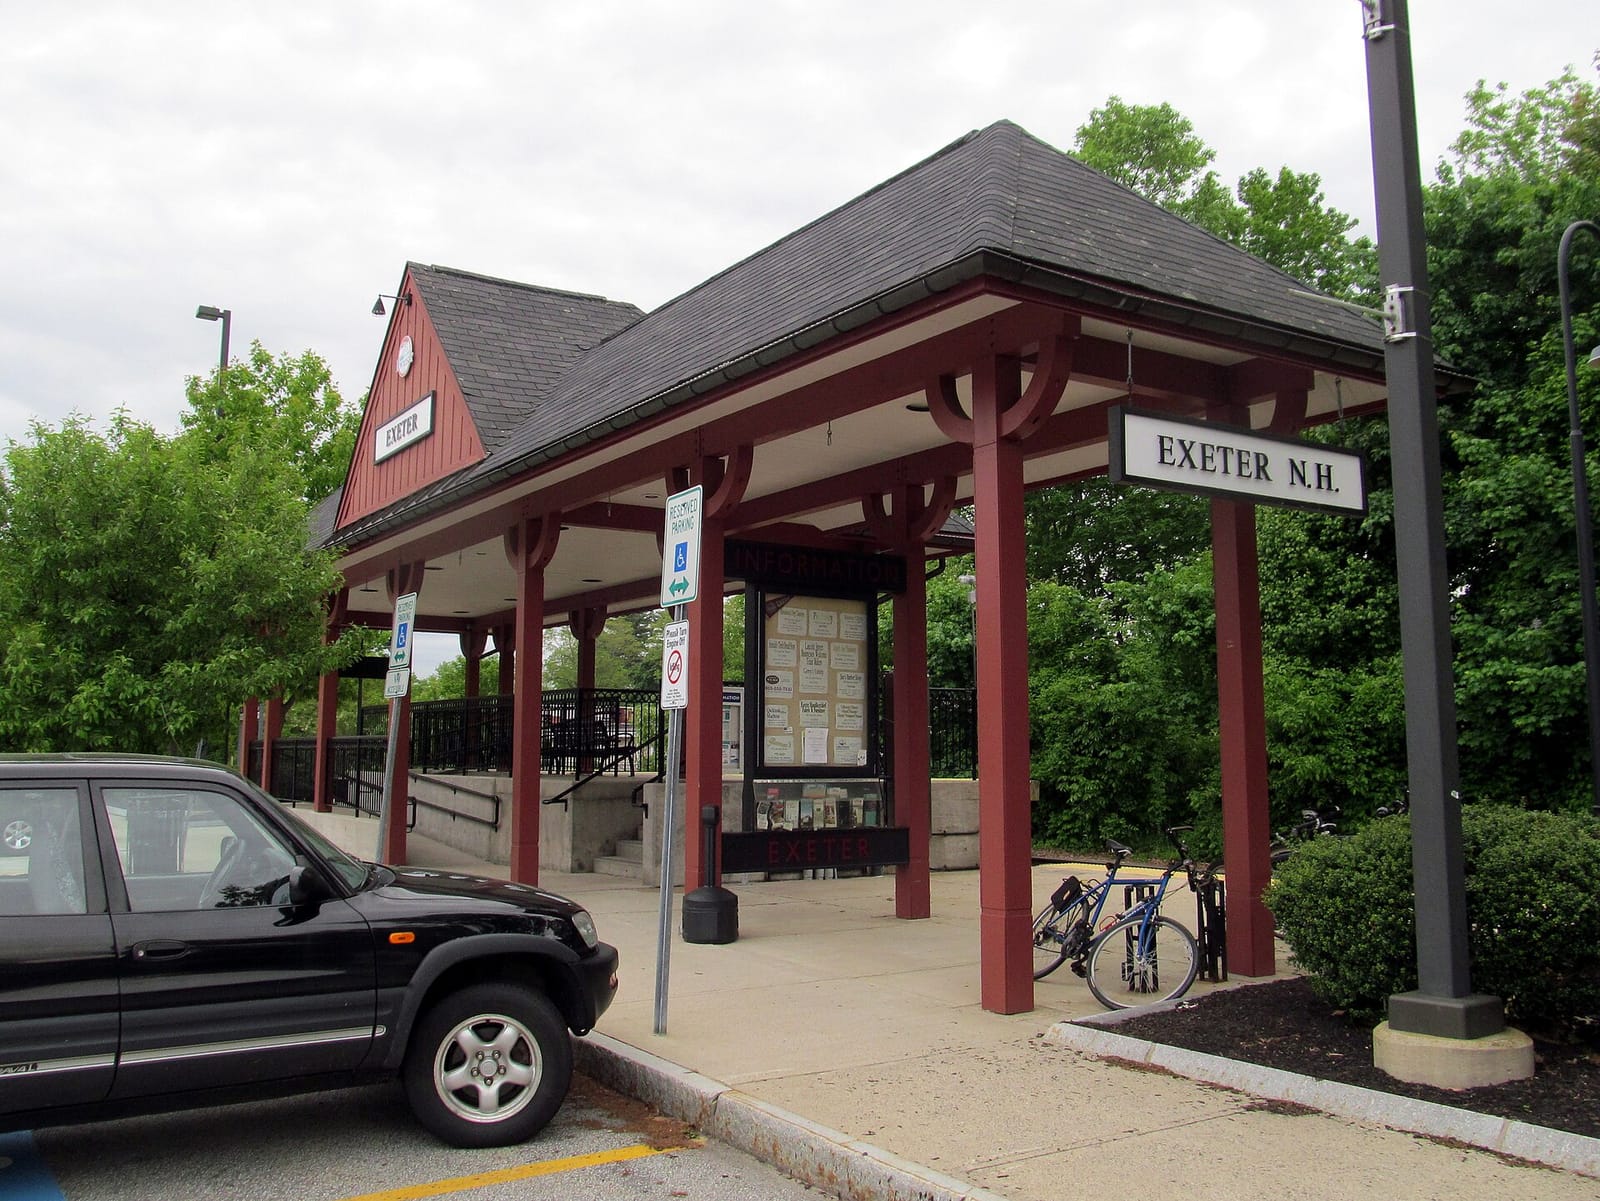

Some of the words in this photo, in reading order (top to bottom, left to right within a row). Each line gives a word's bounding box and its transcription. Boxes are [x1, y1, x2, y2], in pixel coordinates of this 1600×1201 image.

[385, 413, 418, 447] EXETER
[1156, 434, 1273, 482] EXETER
[1288, 458, 1340, 493] N.H.
[669, 498, 698, 520] RESERVED
[672, 515, 694, 536] PARKING
[735, 548, 899, 584] INFORMATION
[768, 838, 870, 864] EXETER
